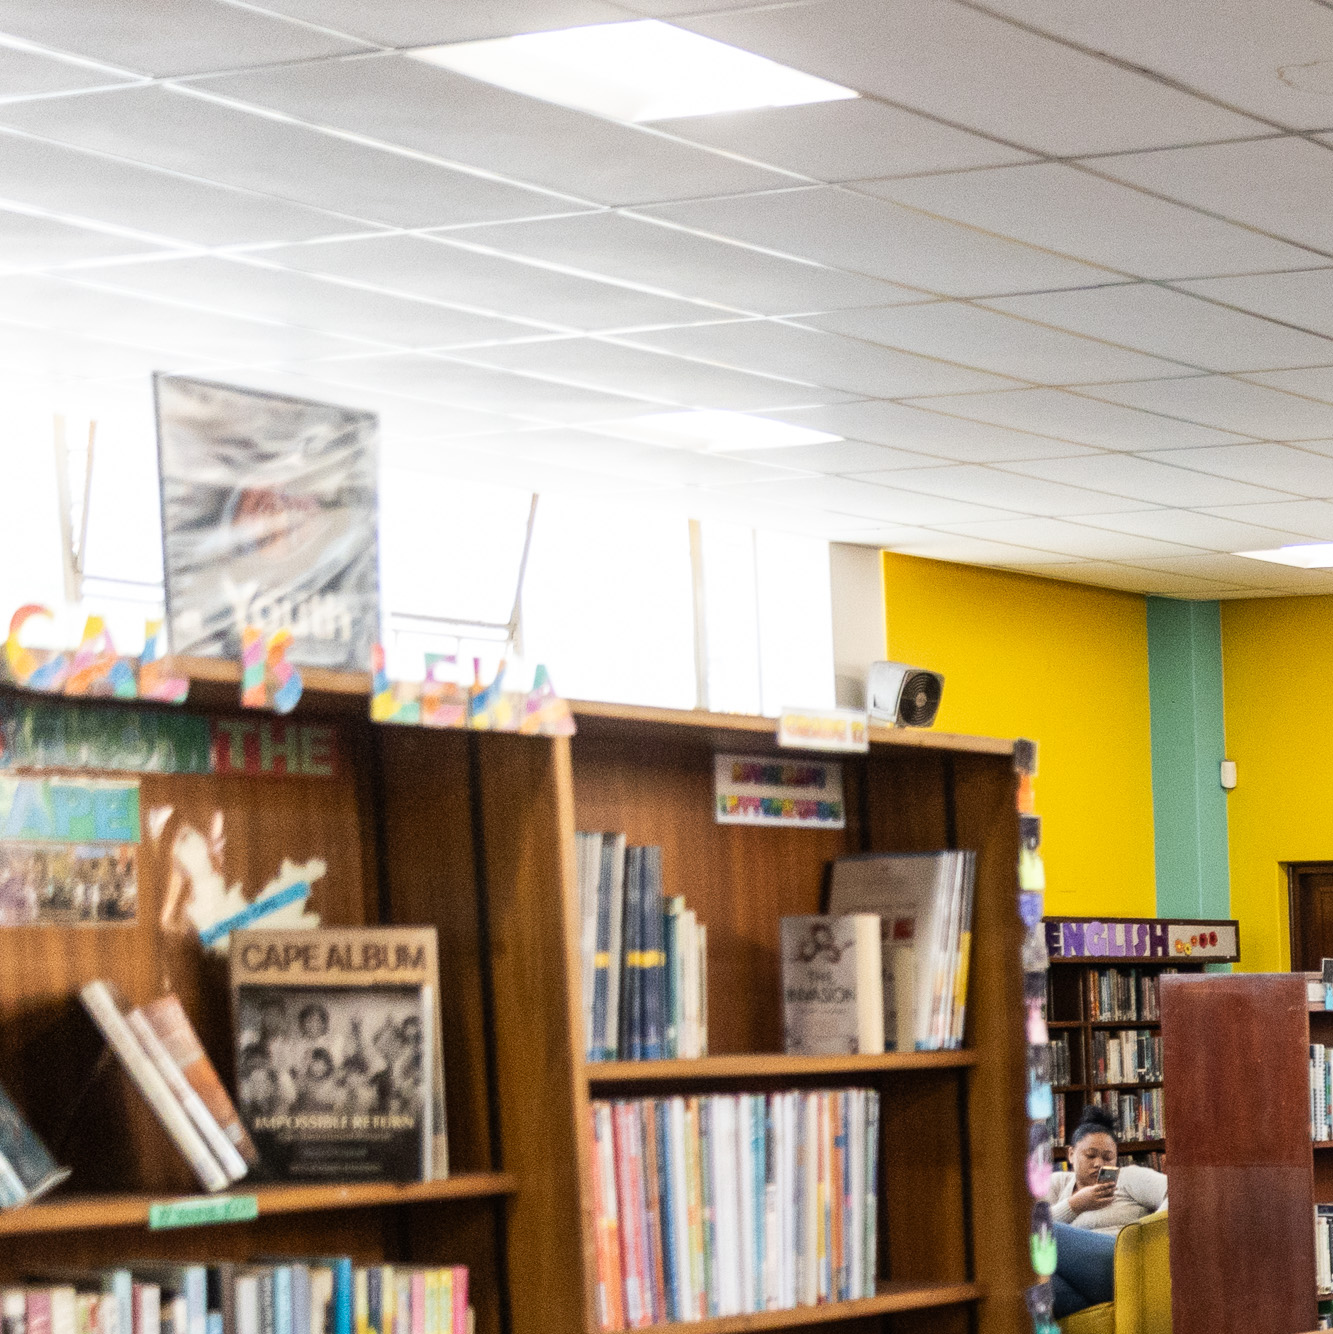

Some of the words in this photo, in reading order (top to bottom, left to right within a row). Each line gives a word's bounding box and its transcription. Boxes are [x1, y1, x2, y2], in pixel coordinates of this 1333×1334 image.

[217, 721, 333, 774] THE
[241, 944, 319, 972] CAPE
[325, 944, 426, 969] ALBUM
[1046, 922, 1169, 958] ENGLISH
